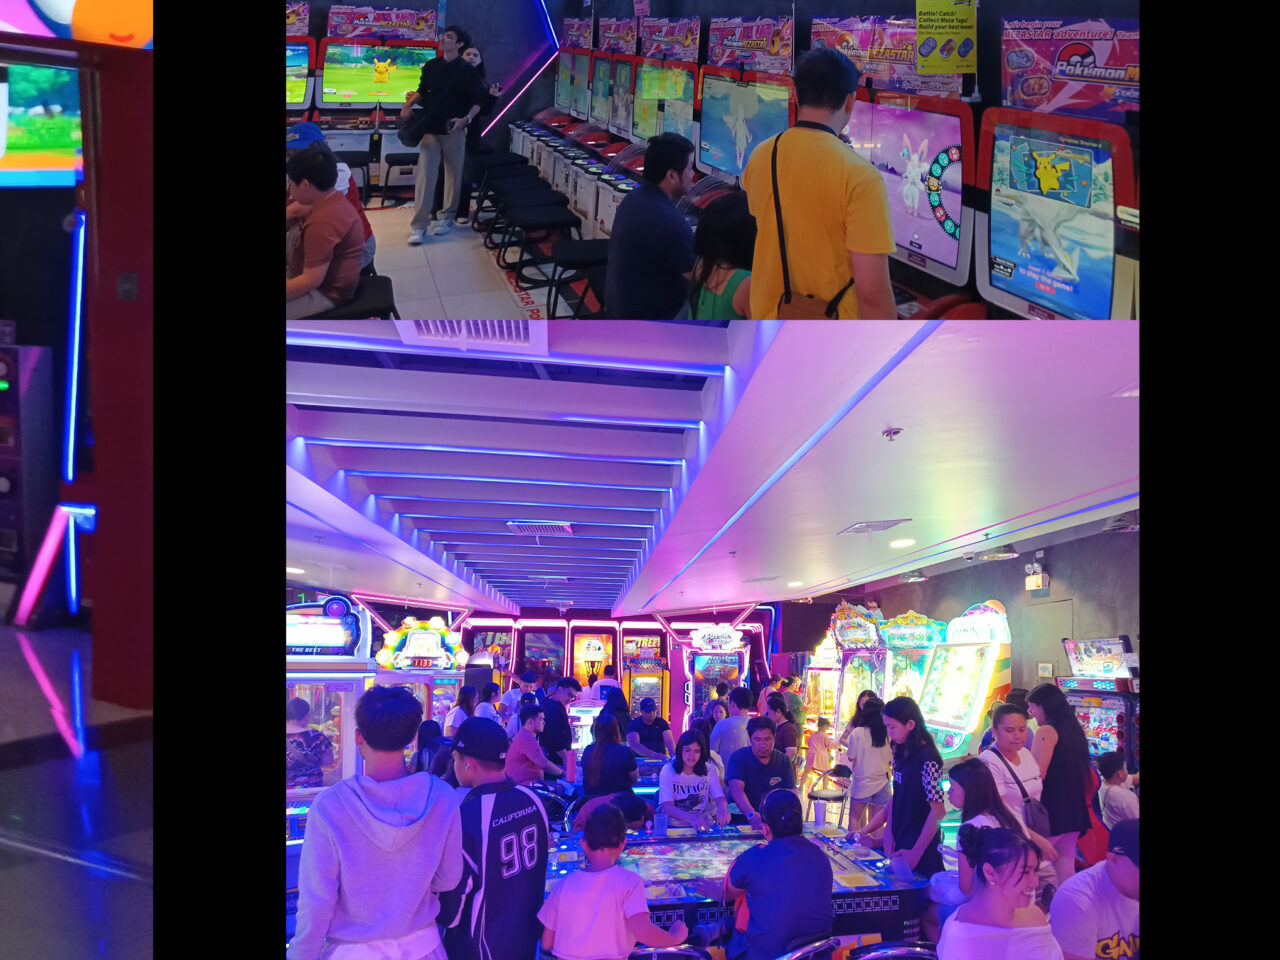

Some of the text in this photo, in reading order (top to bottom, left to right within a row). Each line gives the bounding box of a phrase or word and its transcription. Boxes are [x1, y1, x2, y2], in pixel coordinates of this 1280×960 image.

[1003, 30, 1051, 39] MEZASTAR
[1054, 29, 1114, 39] adventure!
[1019, 20, 1042, 29] begin
[1043, 21, 1062, 29] your
[868, 47, 915, 64] MEZASTAR
[1056, 61, 1125, 80] Pokémon
[1027, 270, 1040, 281] play
[1040, 275, 1052, 284] the
[1052, 280, 1073, 293] game!
[492, 805, 537, 827] CALIFORNIA
[501, 824, 538, 879] 98
